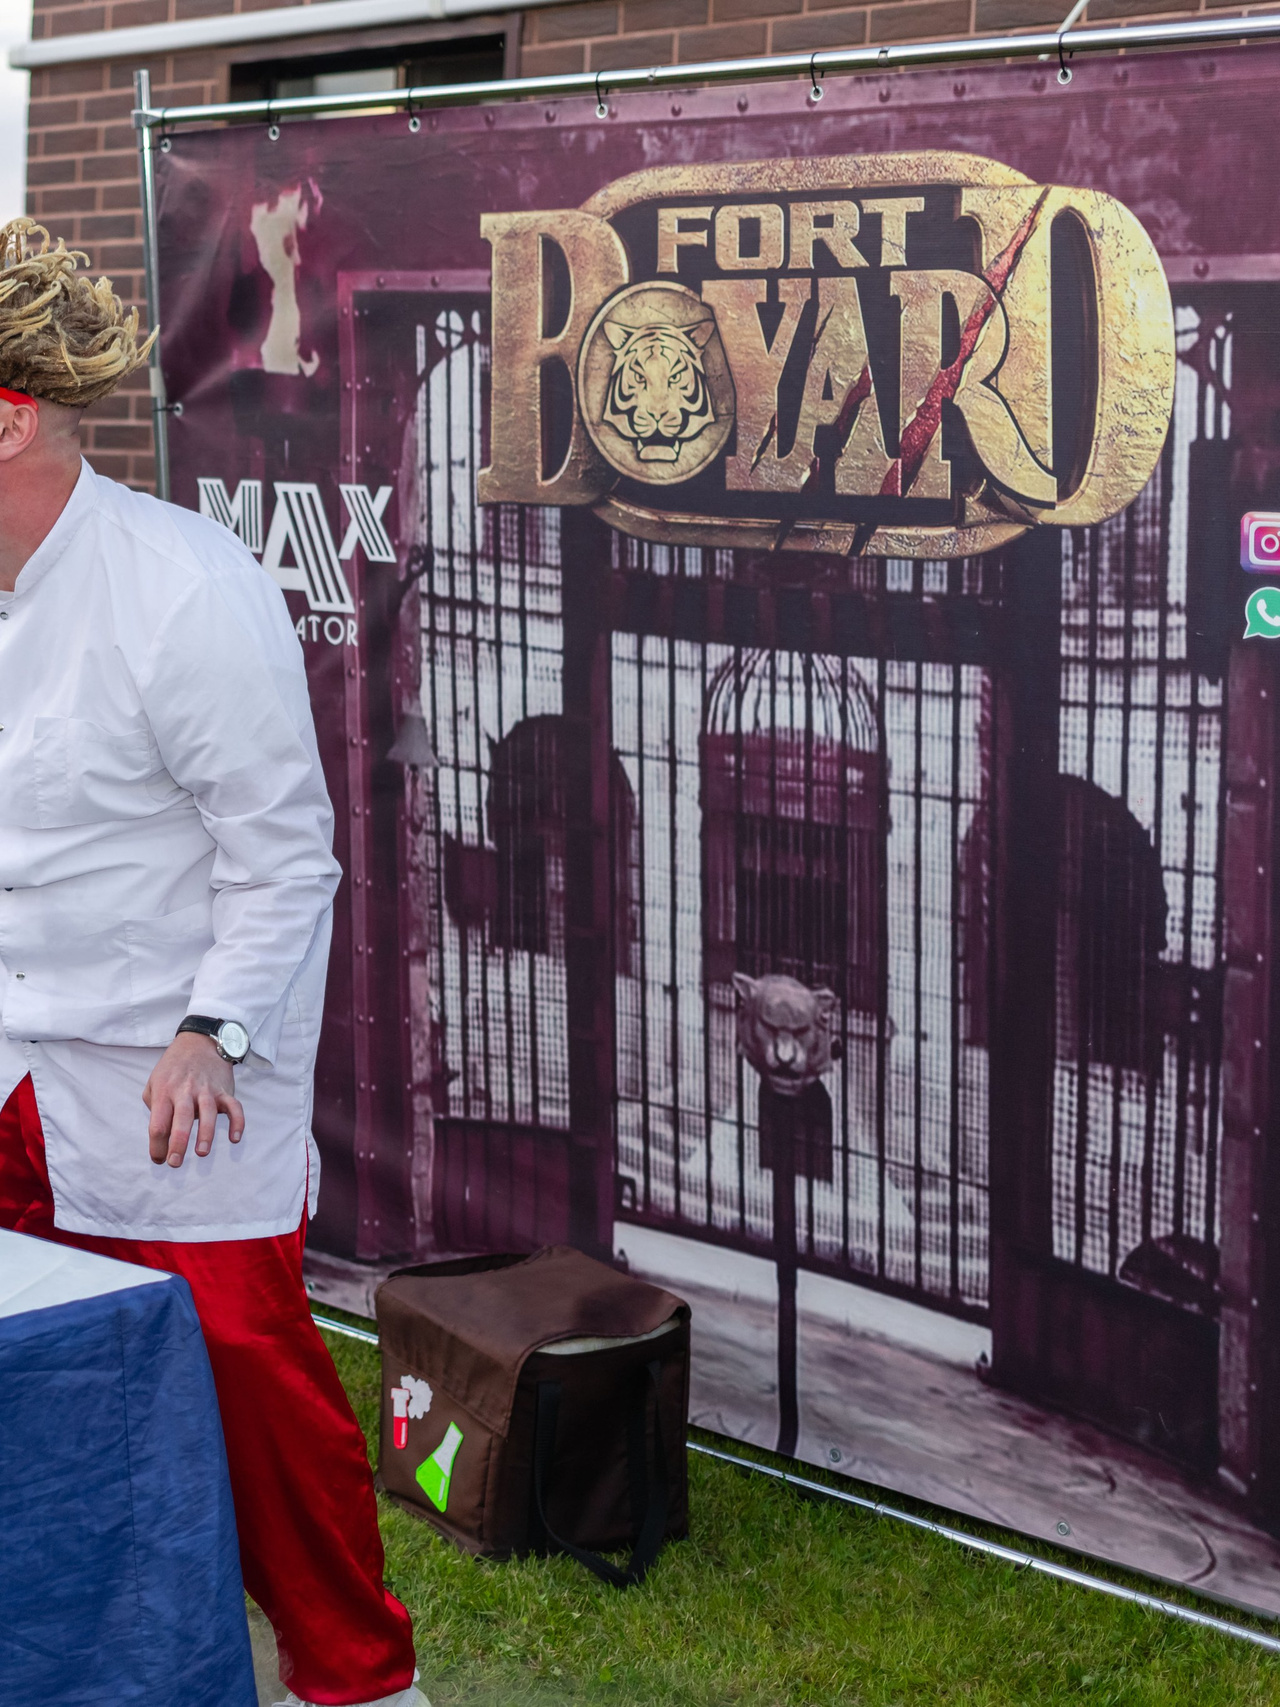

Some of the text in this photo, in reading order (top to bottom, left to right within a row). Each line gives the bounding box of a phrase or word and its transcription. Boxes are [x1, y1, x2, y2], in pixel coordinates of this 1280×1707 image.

[656, 196, 926, 275] FORT
[196, 477, 397, 614] MAX
[295, 614, 359, 647] ATOR
